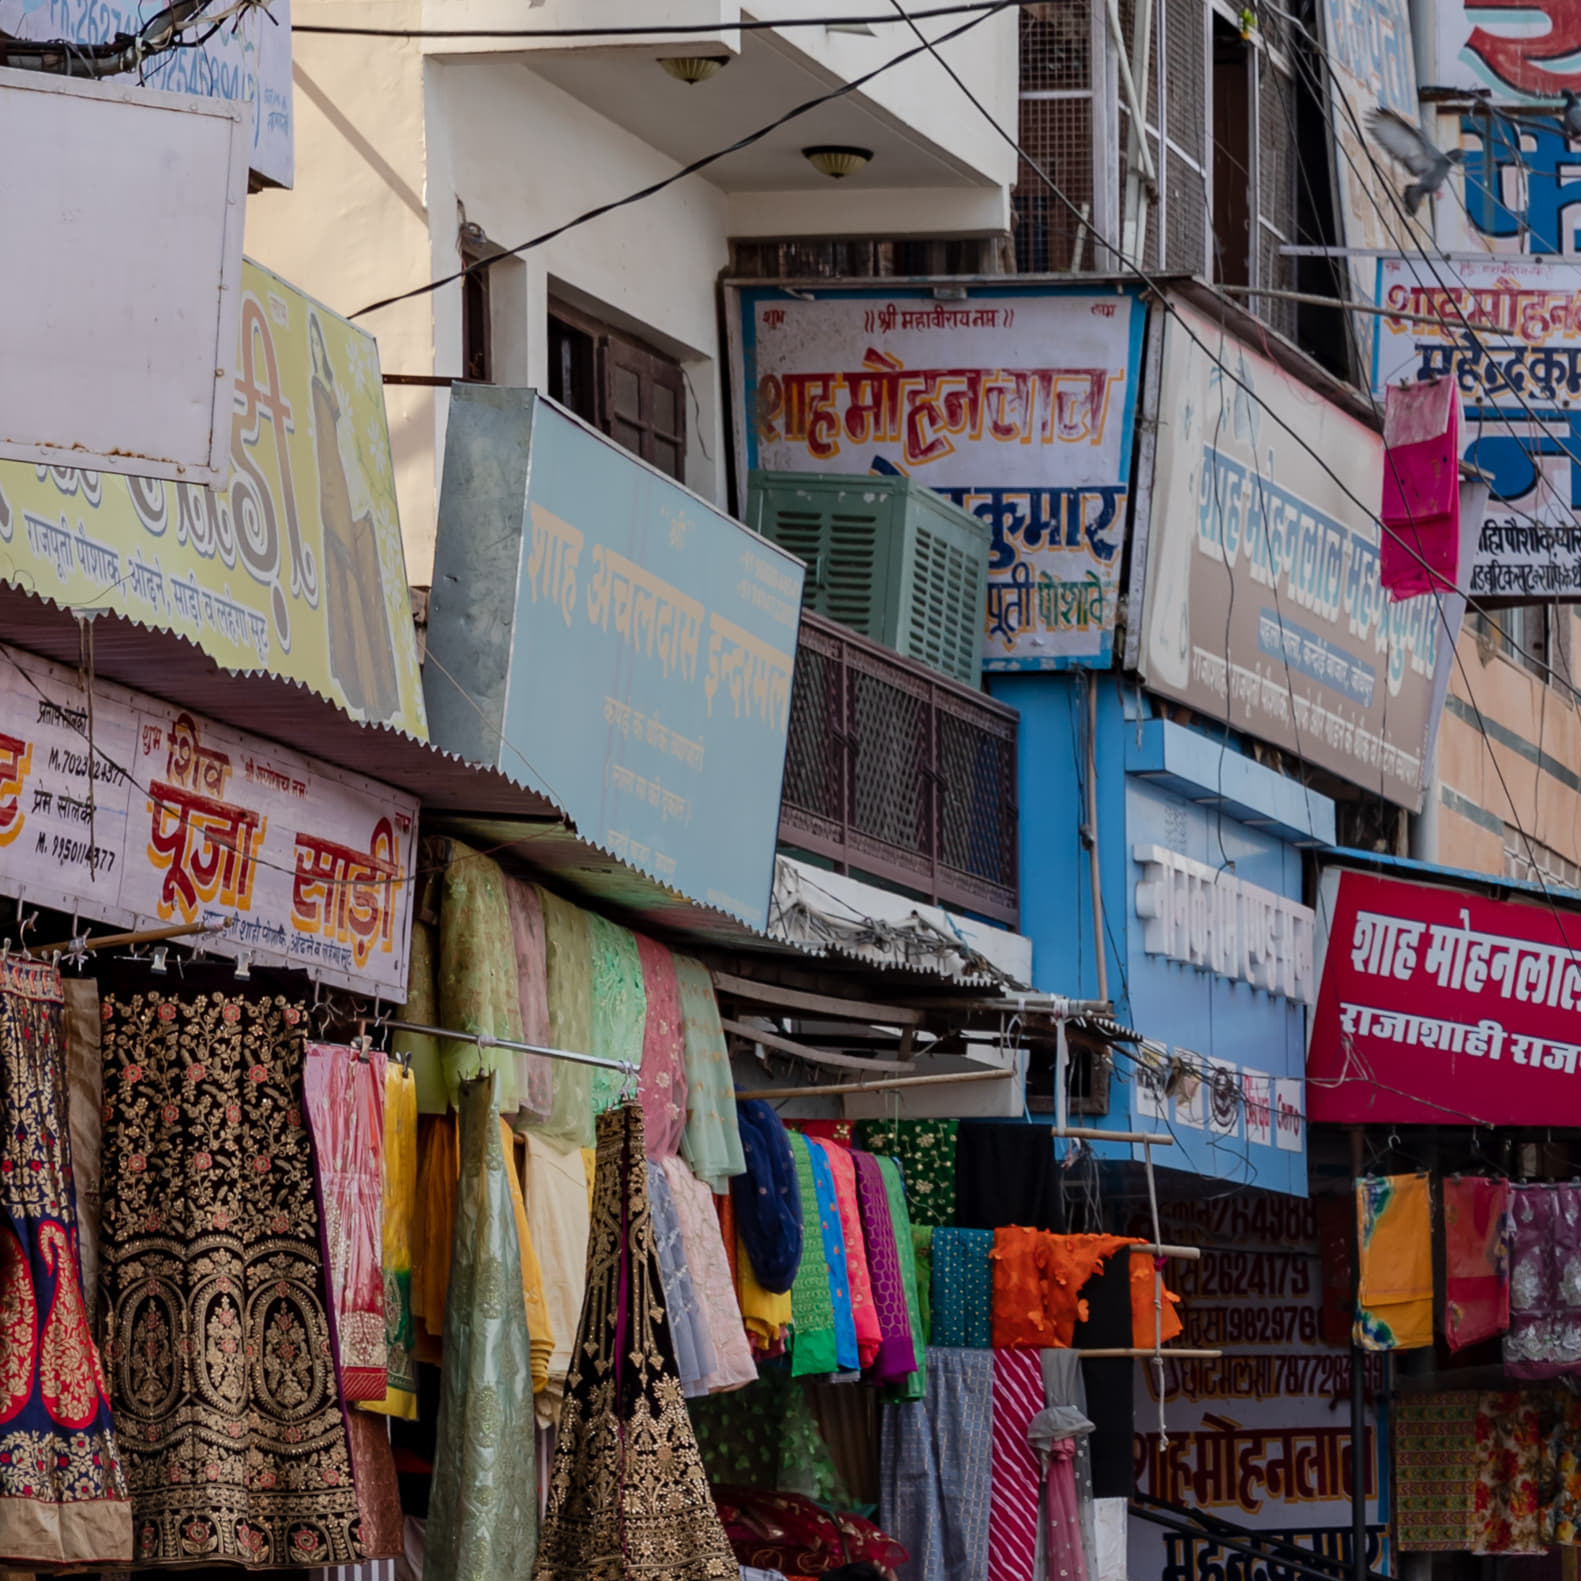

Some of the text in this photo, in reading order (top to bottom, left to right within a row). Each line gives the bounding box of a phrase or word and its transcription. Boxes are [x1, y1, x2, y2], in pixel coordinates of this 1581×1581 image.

[24, 515, 75, 578] राजपूती
[1200, 443, 1244, 567] शाह
[1242, 448, 1346, 624] मोहनलाल
[526, 501, 584, 628] शाह
[586, 543, 705, 683] अचलदास
[142, 722, 163, 756] शुभ
[166, 712, 232, 799] शिव
[31, 780, 54, 816] प्रेम
[147, 779, 267, 924] पूजा
[289, 815, 403, 968] साड़ी
[1350, 909, 1426, 981] शाह
[1338, 1001, 1507, 1061] राजाशाही
[1202, 1253, 1309, 1297] 2624179
